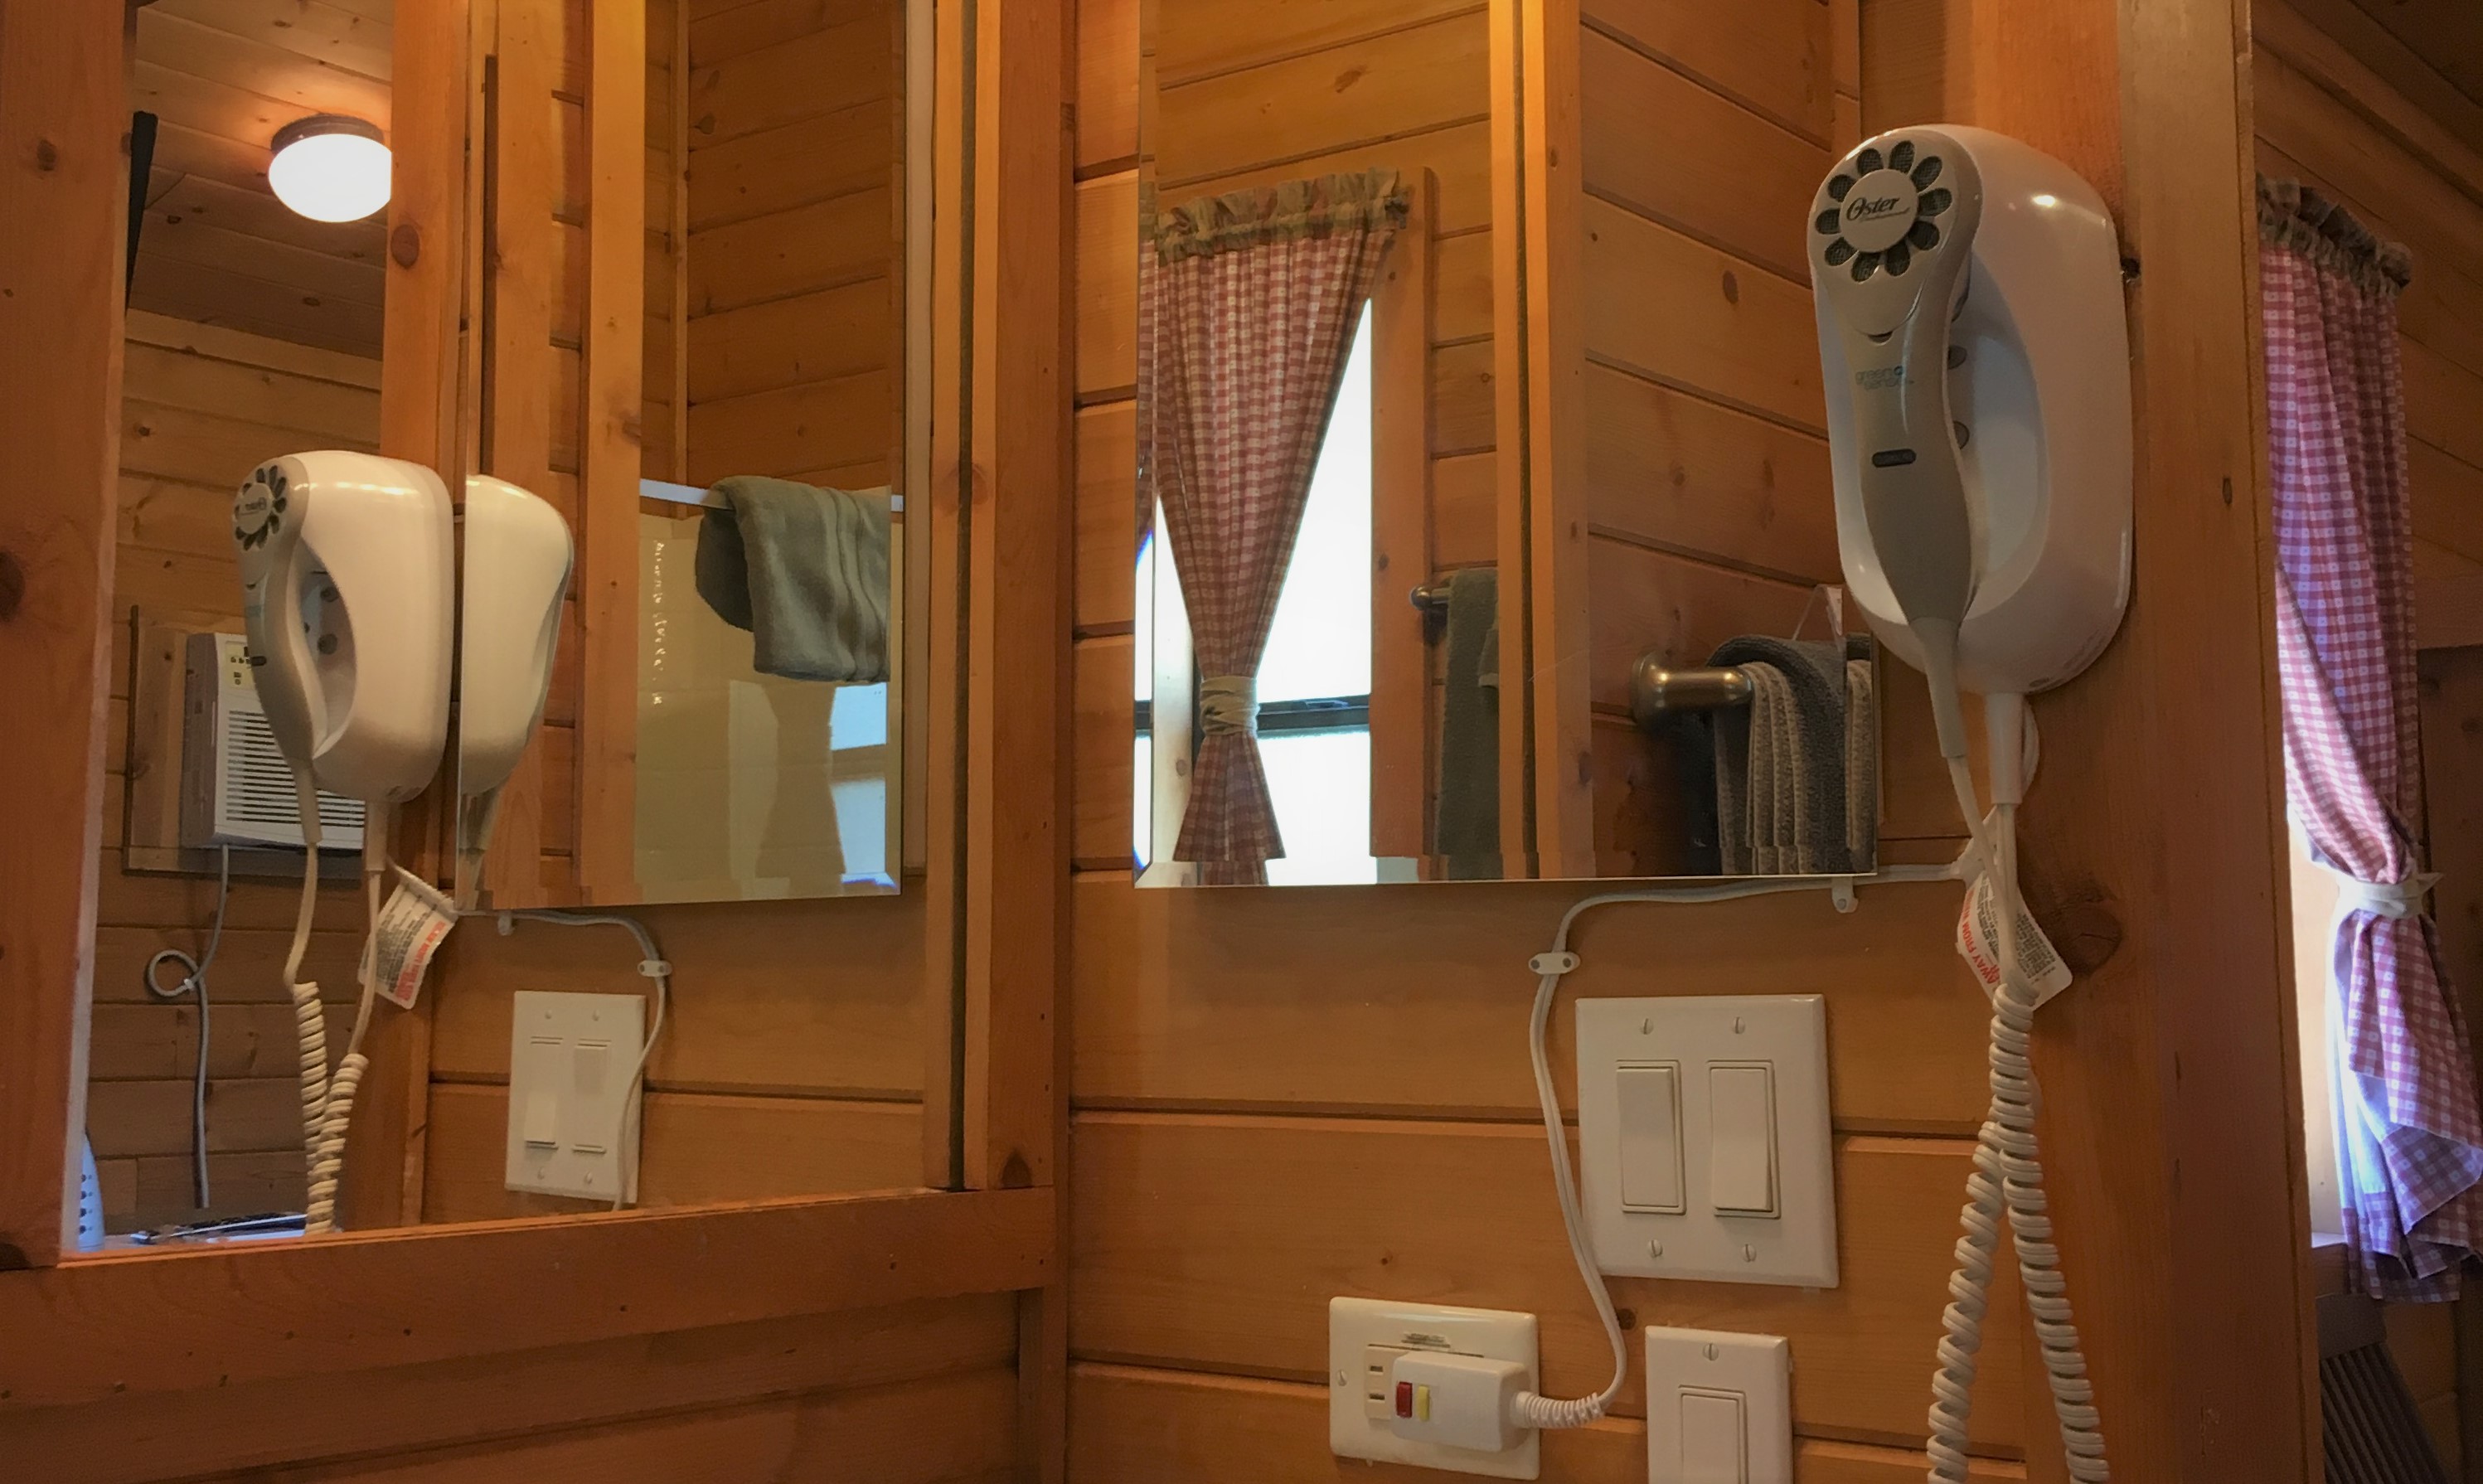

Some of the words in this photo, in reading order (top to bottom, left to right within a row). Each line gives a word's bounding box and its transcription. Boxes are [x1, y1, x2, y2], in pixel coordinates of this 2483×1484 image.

[1846, 195, 1900, 221] Oster
[1962, 921, 1977, 953] FROM
[1971, 953, 1996, 983] AWAY
